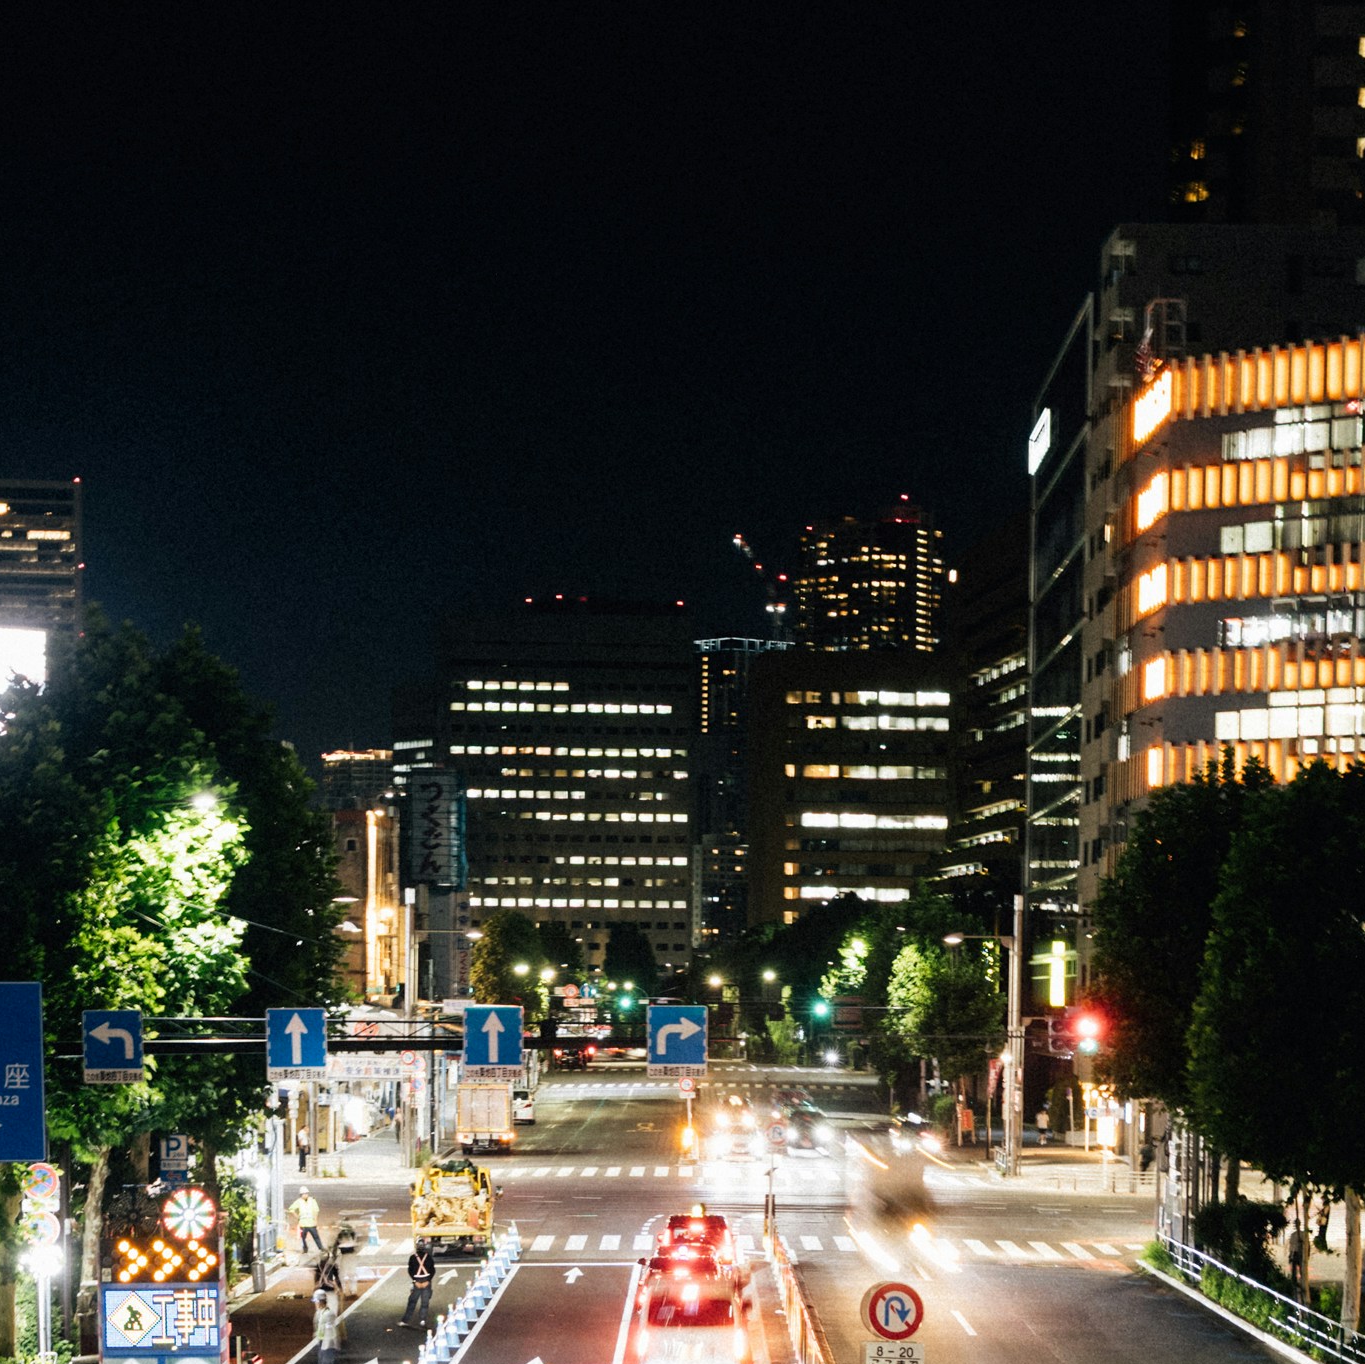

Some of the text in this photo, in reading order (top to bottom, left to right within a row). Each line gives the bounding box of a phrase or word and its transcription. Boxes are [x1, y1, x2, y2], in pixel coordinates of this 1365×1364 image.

[166, 1137, 181, 1158] P
[151, 1289, 216, 1345] 工事中
